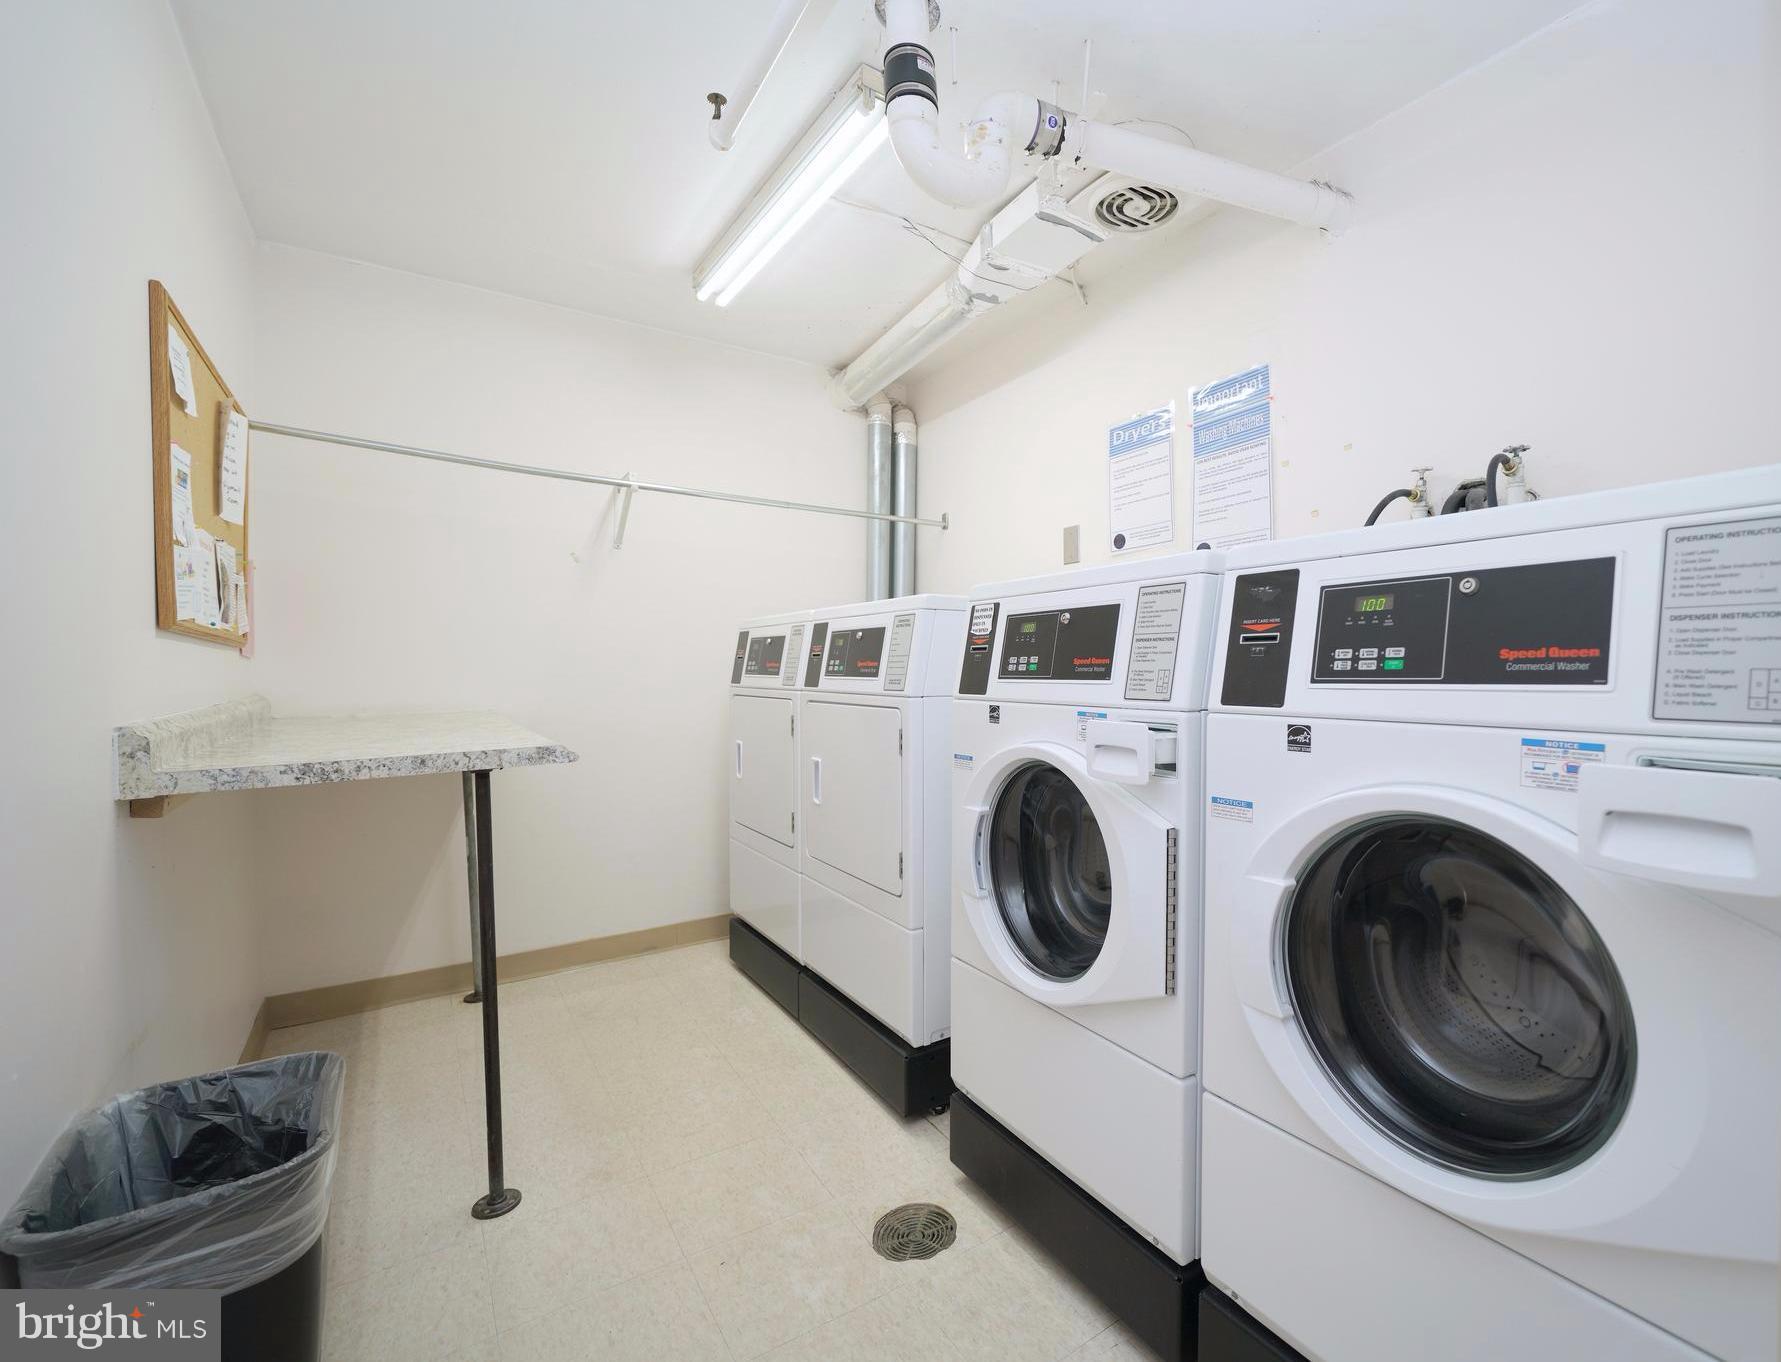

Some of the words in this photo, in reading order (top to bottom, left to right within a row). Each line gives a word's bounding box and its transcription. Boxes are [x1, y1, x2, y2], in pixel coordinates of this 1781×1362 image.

[1113, 414, 1166, 445] Dryers
[1674, 531, 1724, 544] OPERATING
[1669, 613, 1719, 621] DISPENSER
[1498, 647, 1546, 660] Speed
[1548, 646, 1600, 658] Queen
[1506, 661, 1555, 671] Commercial
[1557, 661, 1590, 671] Washer
[1545, 740, 1580, 749] NOTICE
[1216, 798, 1246, 807] NOTICE
